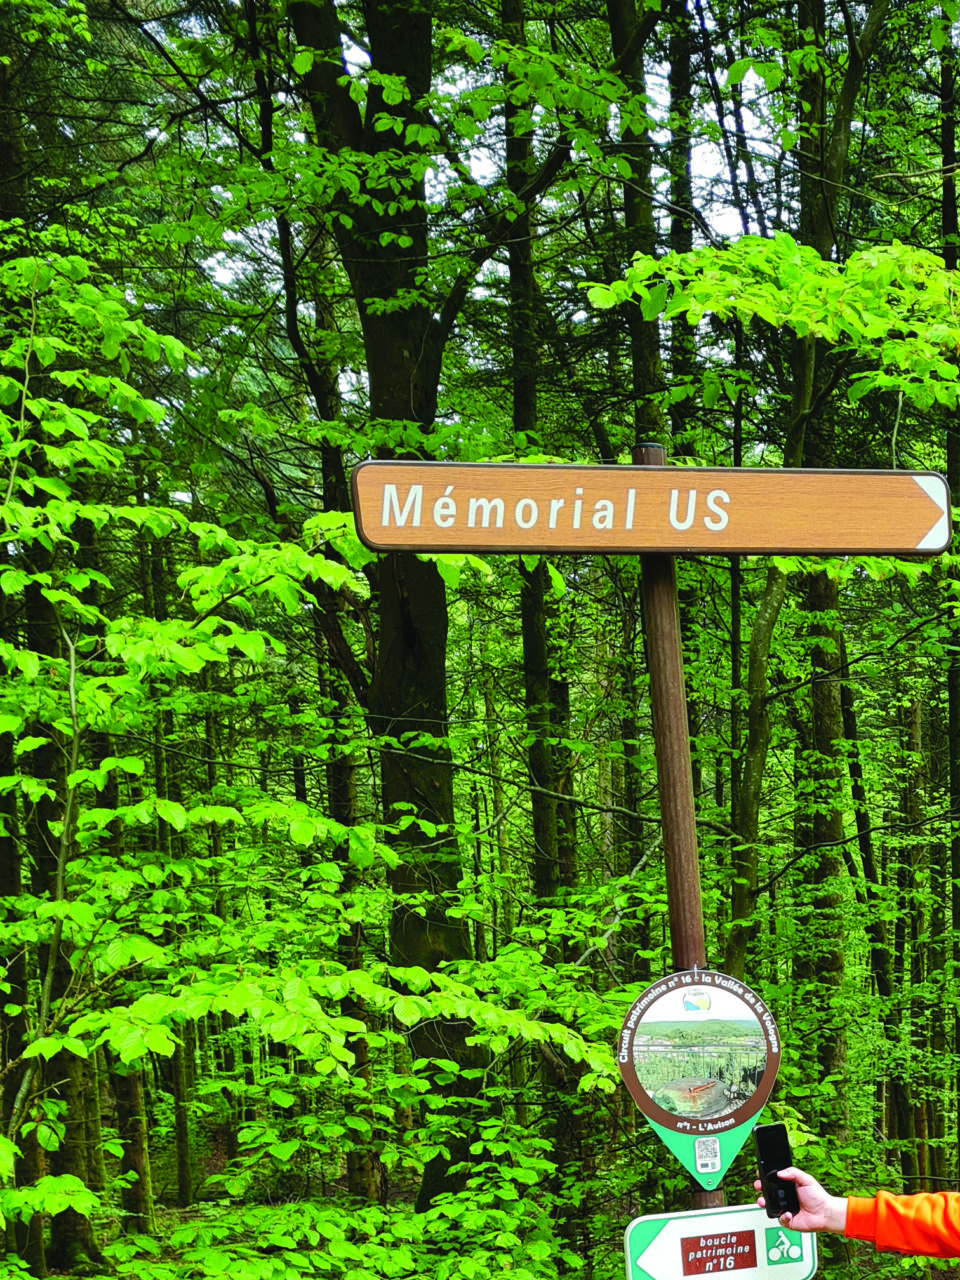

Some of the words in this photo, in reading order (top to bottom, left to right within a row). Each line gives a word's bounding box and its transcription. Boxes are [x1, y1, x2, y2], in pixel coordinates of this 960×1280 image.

[380, 482, 636, 531] Mémorial
[667, 489, 731, 532] US
[619, 1029, 632, 1063] Circuit
[627, 983, 667, 1029] patrimoine
[681, 974, 692, 984] 16
[701, 973, 712, 983] la
[715, 976, 744, 995] Vallée
[744, 992, 756, 1004] de
[754, 1001, 764, 1014] la
[762, 1012, 779, 1053] Vologne
[698, 1117, 736, 1131] L'Avison
[700, 1234, 736, 1247] boucle
[688, 1245, 749, 1261] patrimoine
